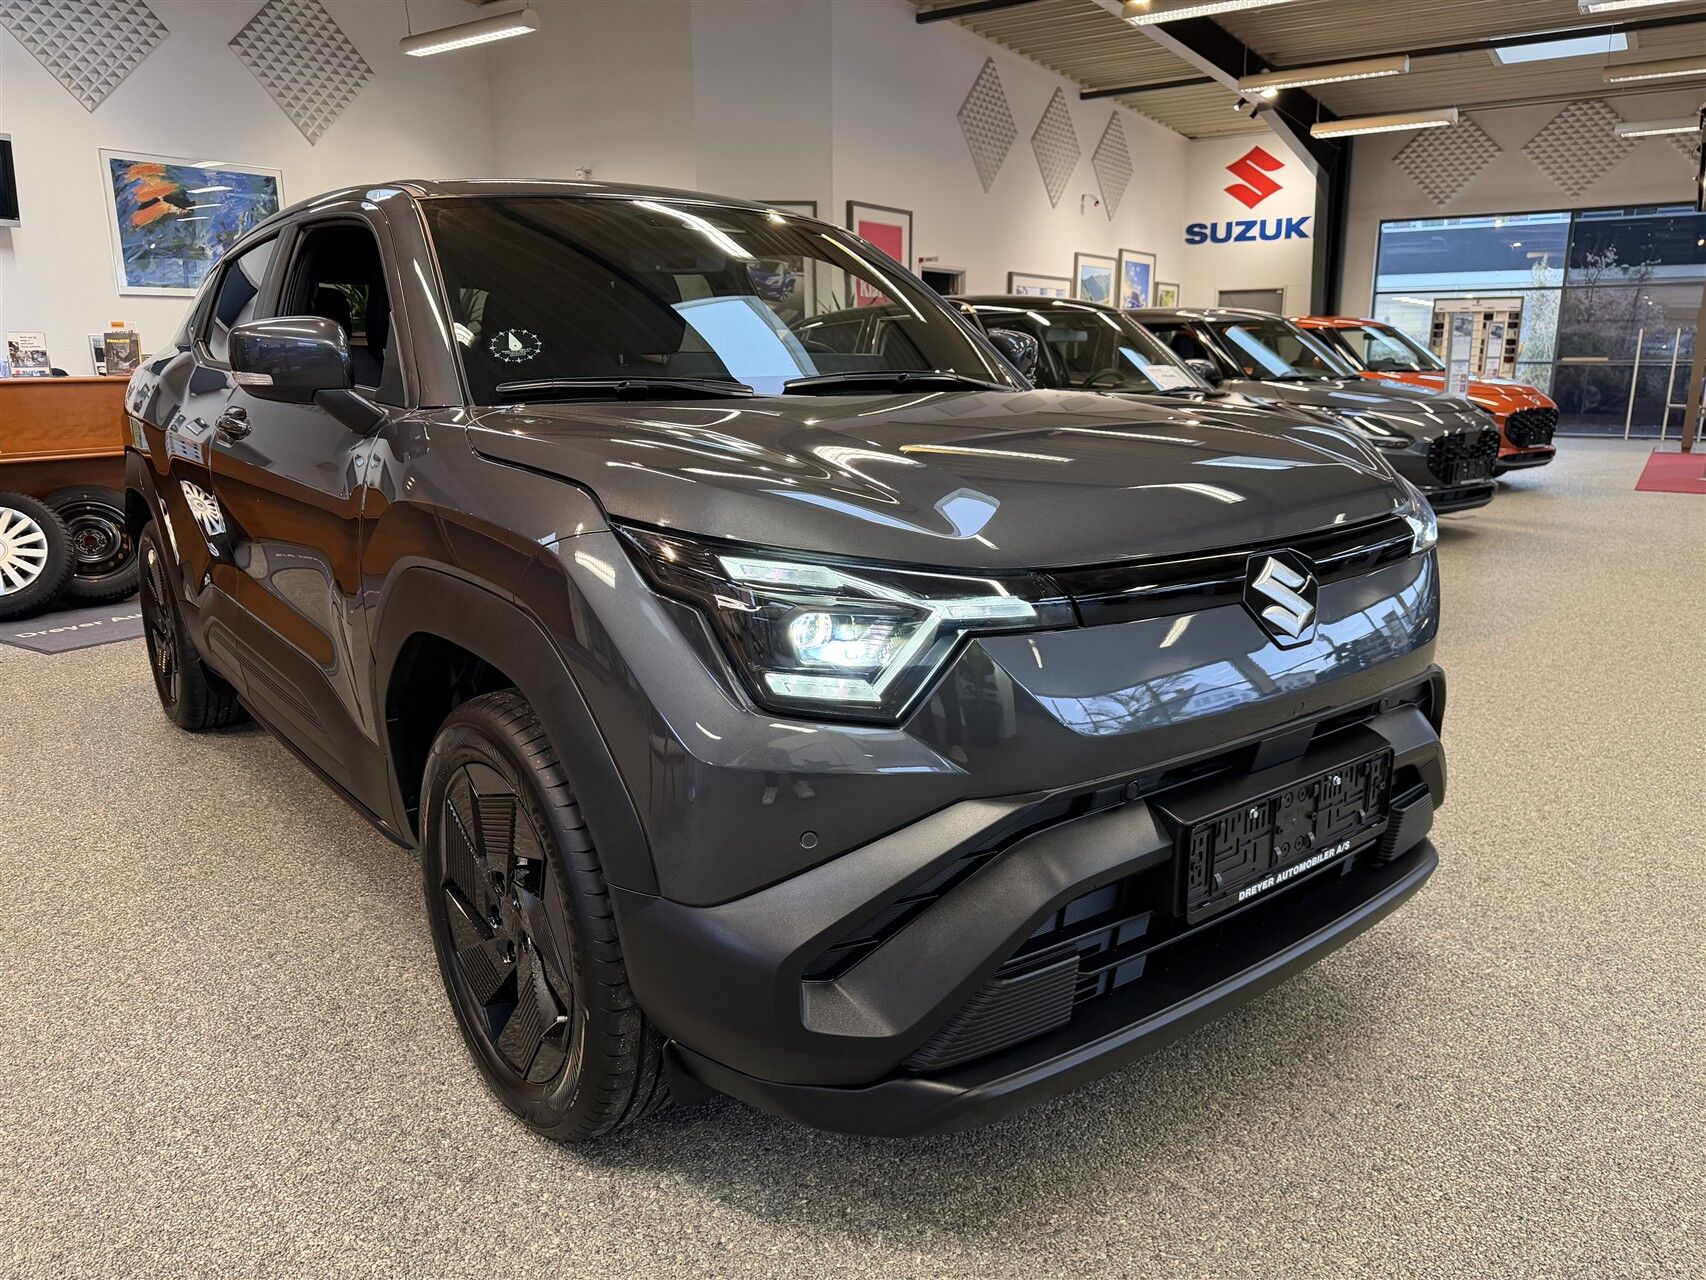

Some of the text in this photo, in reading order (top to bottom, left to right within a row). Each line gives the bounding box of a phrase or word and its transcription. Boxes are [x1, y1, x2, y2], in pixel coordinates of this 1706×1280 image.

[15, 620, 102, 638] Dreyer
[1239, 841, 1350, 901] DREYER AUTOMOBILER A/S
